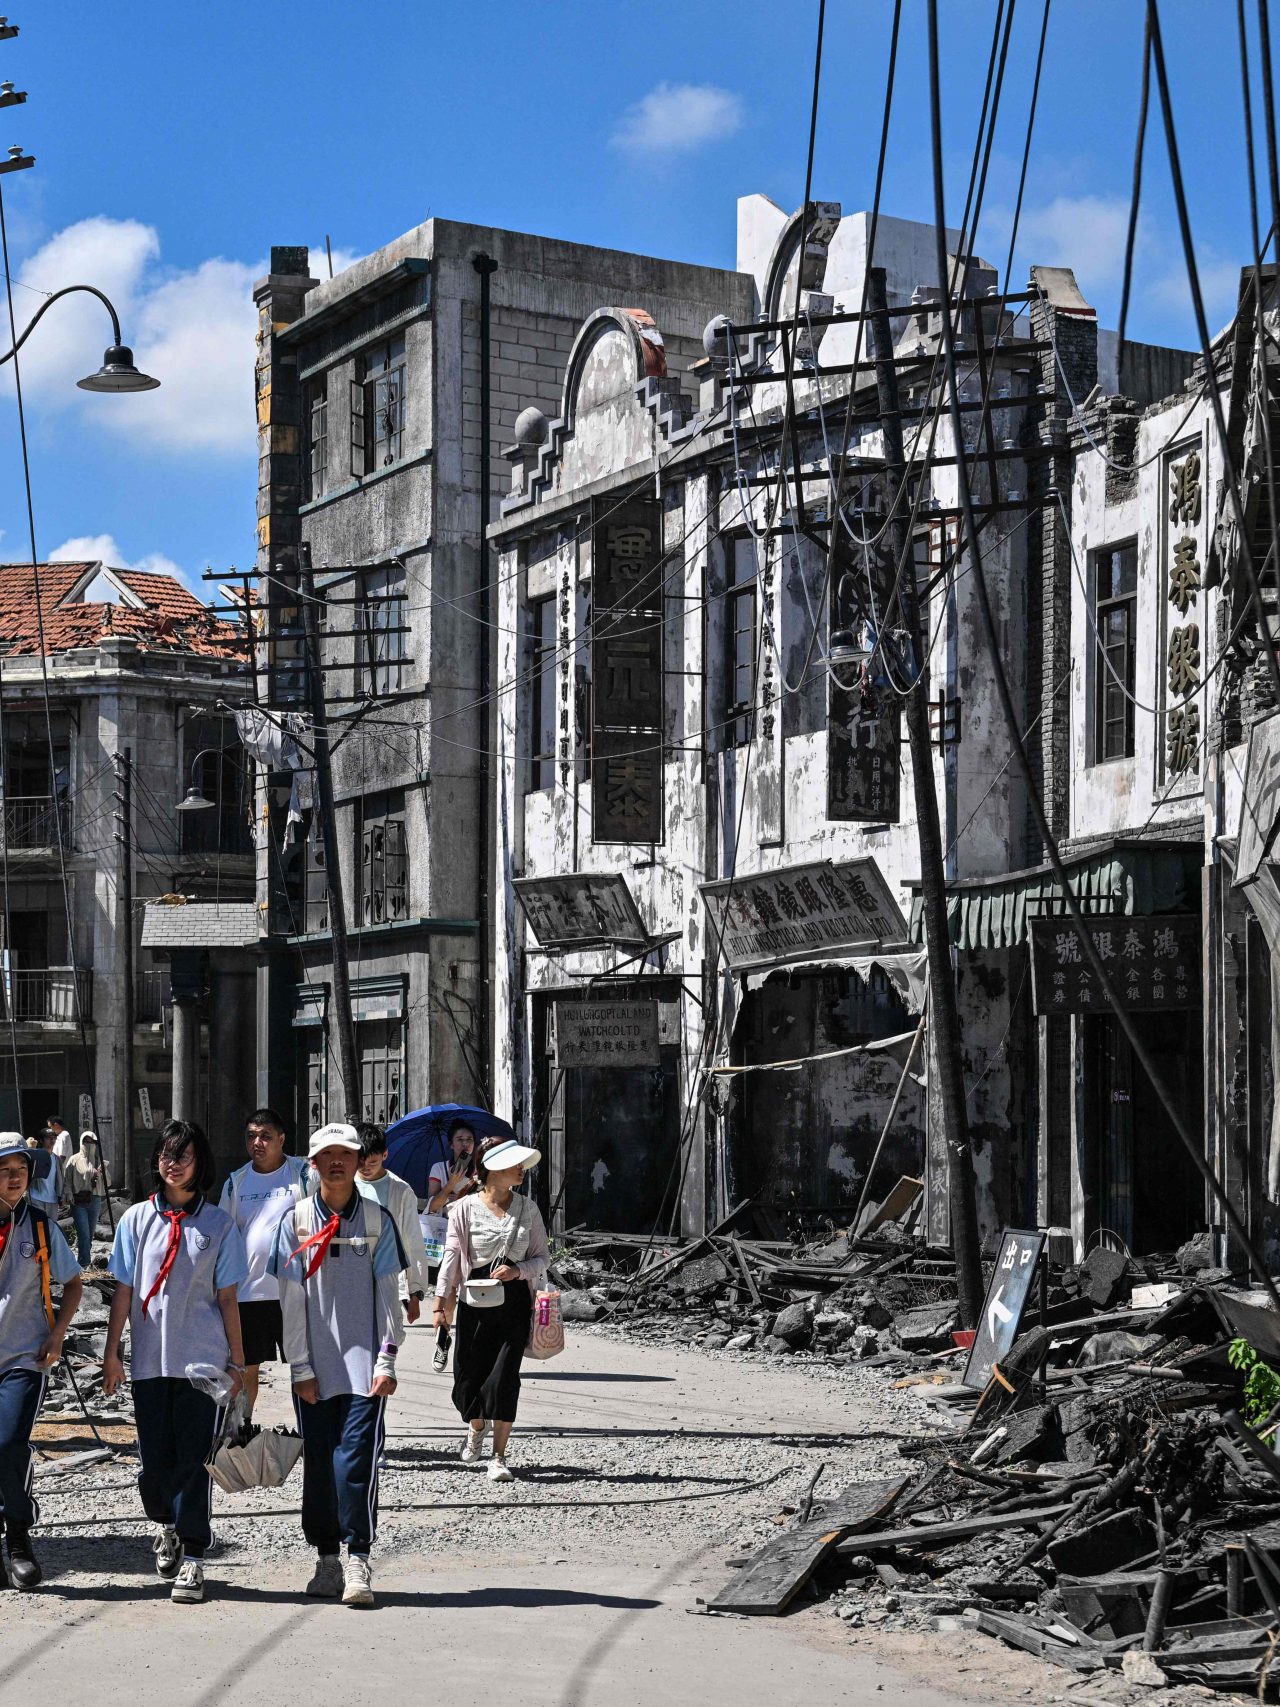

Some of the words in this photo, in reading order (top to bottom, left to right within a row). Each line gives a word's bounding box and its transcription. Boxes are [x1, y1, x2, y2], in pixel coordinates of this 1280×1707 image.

[1166, 450, 1201, 775] 鴻泰銀號
[801, 921, 824, 942] AND
[1055, 927, 1180, 965] 鴻泰銀號
[1001, 1240, 1033, 1271] 出口
